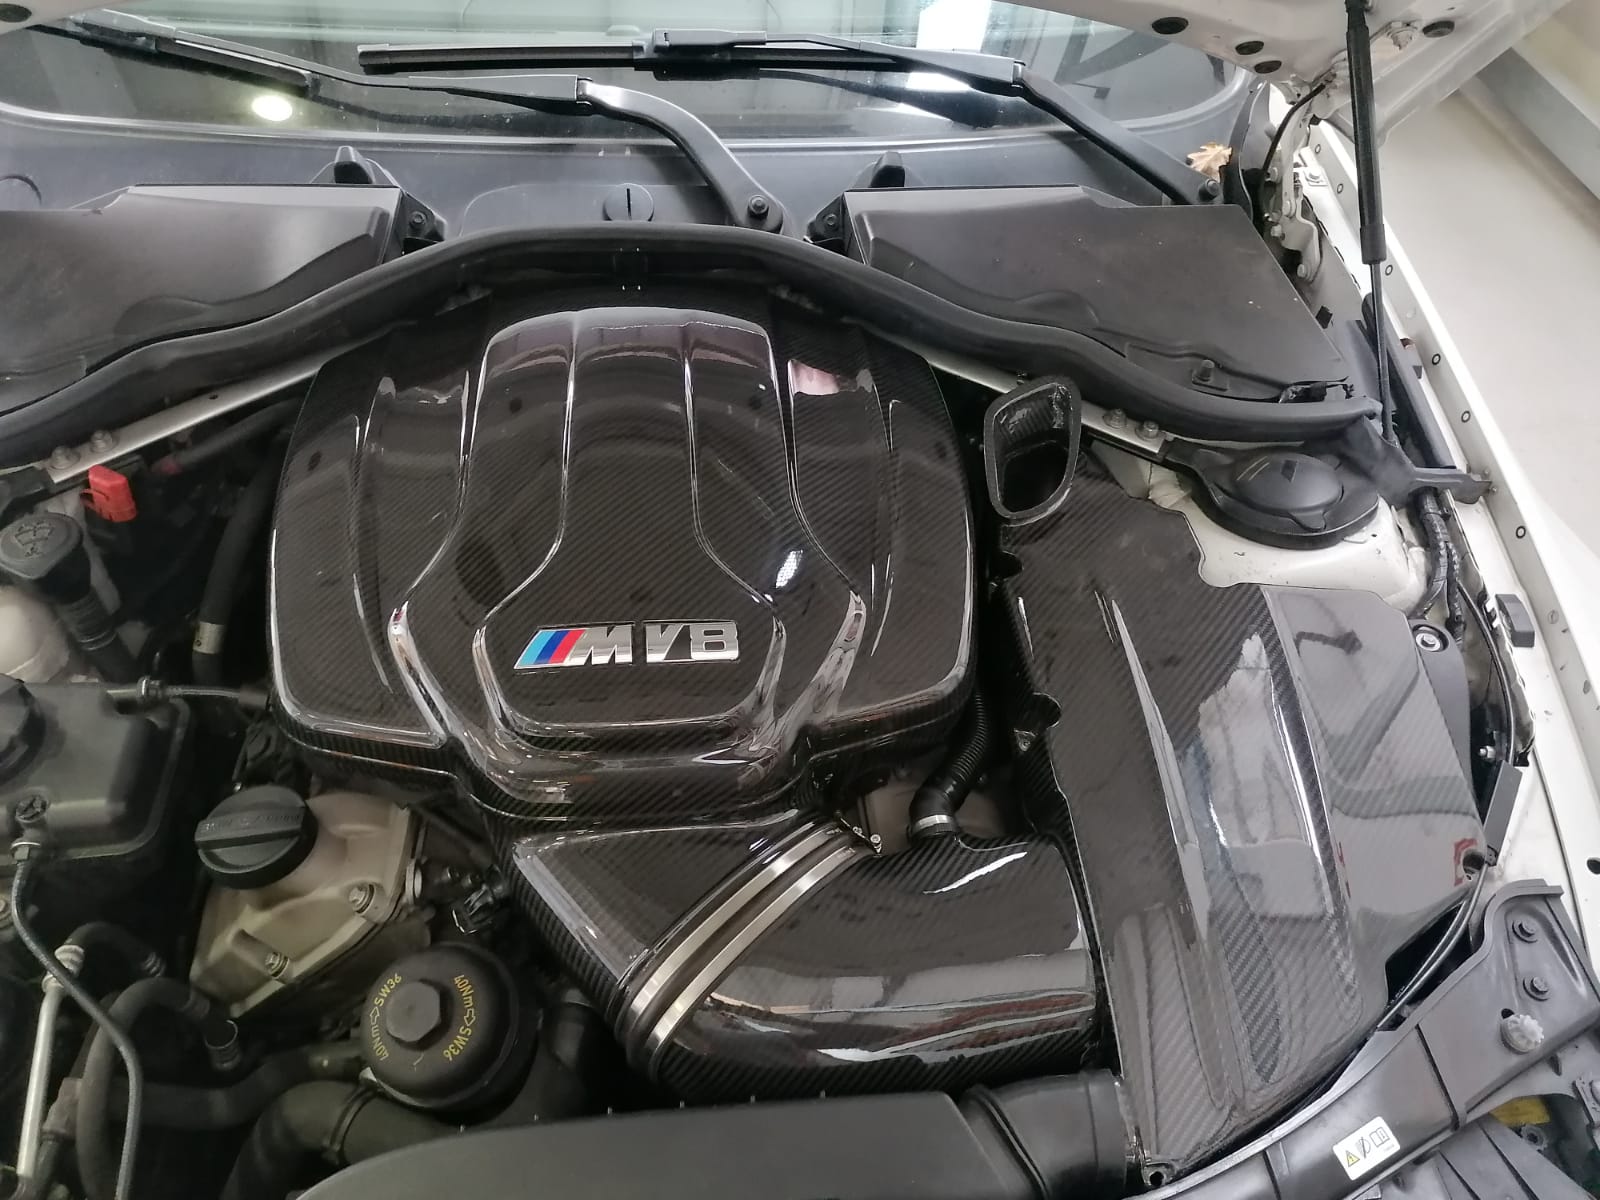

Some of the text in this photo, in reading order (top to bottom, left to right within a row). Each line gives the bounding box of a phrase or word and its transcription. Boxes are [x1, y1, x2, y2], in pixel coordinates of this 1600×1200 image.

[374, 972, 402, 1007] SW36
[443, 974, 474, 1061] 40Nm SW36
